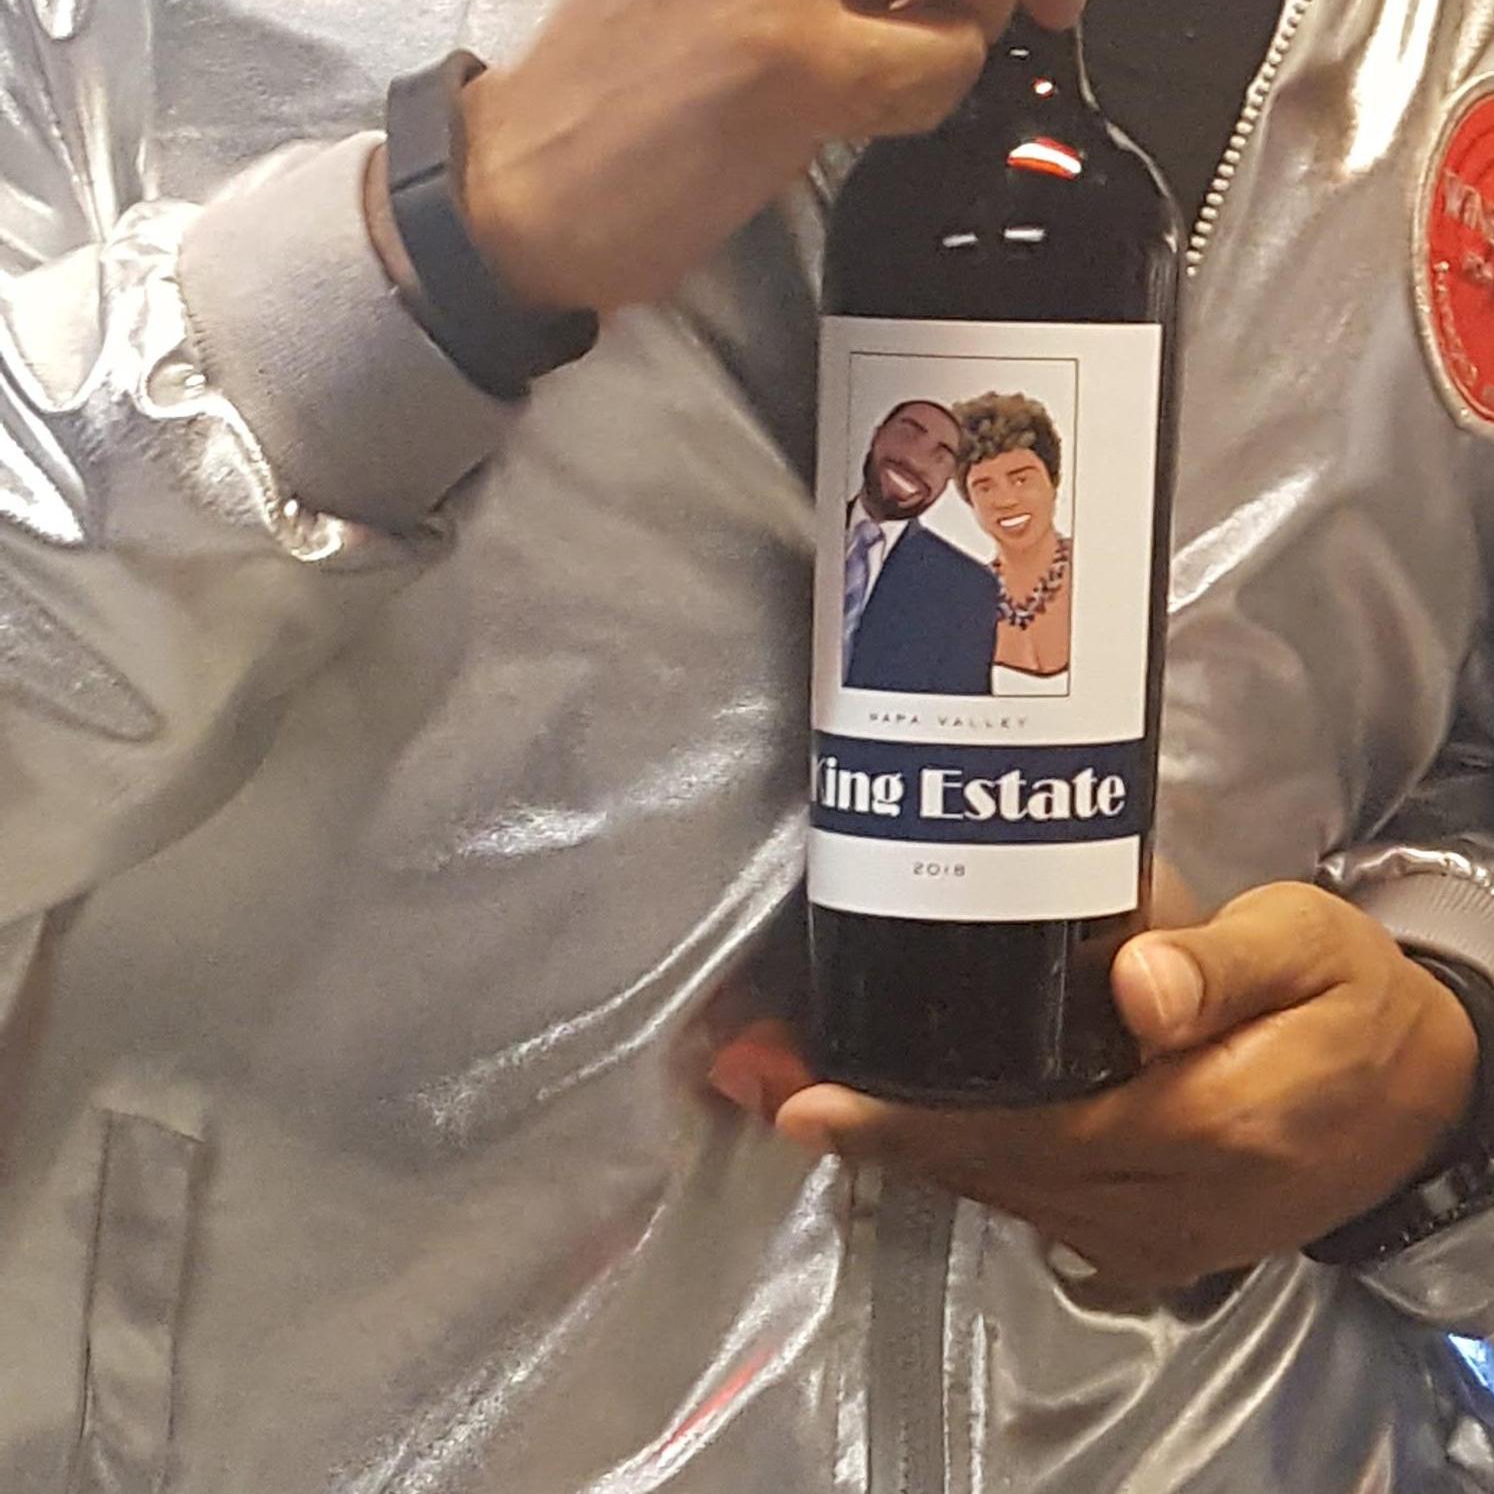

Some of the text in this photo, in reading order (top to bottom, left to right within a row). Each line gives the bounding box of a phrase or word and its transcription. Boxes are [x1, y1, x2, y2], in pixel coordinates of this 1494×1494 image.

[868, 712, 1028, 729] NAPA VALLEY
[919, 766, 1127, 822] Estate
[912, 861, 966, 878] 2018
